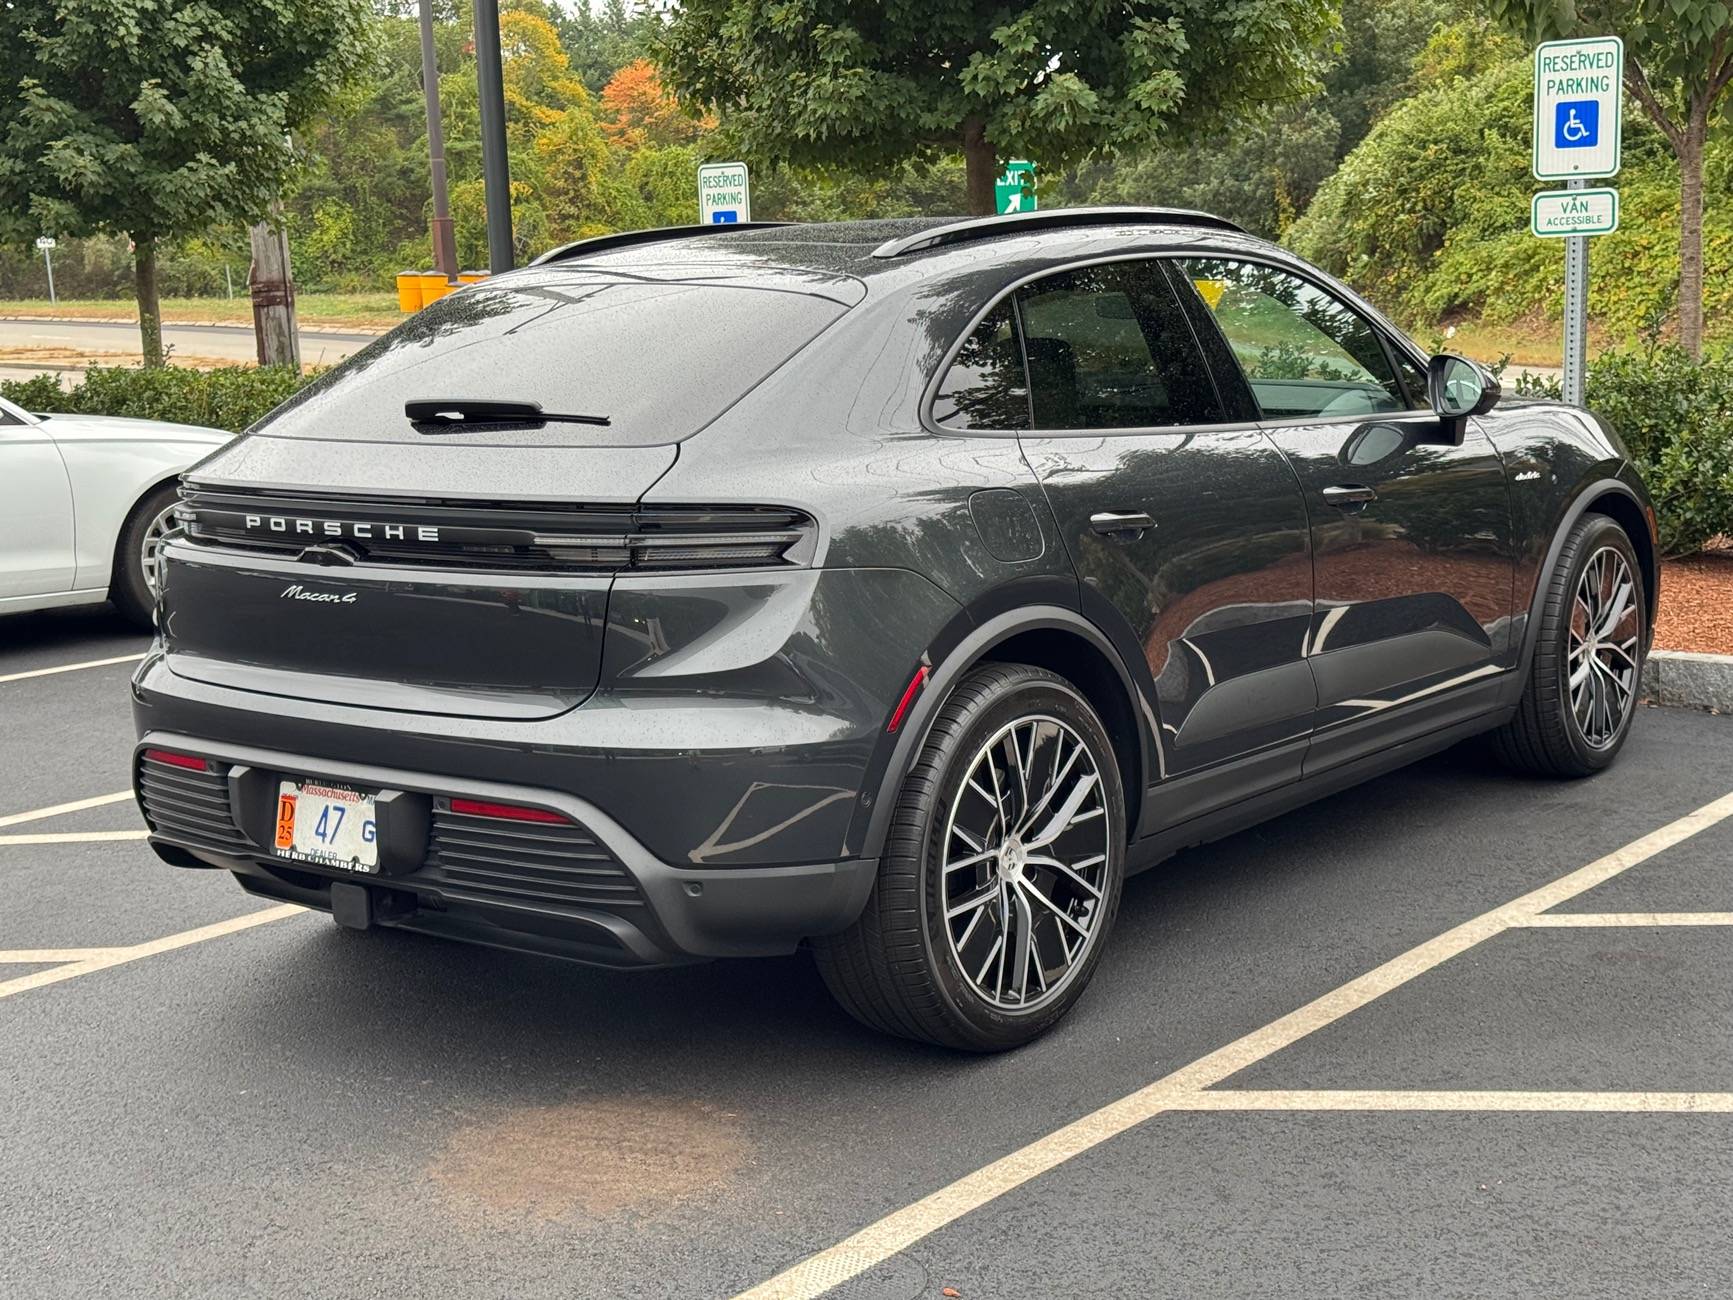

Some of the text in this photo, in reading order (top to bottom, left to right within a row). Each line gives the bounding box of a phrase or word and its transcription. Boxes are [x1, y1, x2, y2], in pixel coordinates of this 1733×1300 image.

[1543, 51, 1614, 73] RESERVED
[1546, 75, 1609, 96] PARKING
[702, 174, 743, 189] RESERVED
[706, 191, 742, 206] PARKING
[1561, 201, 1588, 214] VAN
[1546, 215, 1602, 226] ACCESSIBLE
[246, 515, 439, 542] PORSCHE
[280, 584, 340, 603] Macan
[301, 783, 361, 803] Massachusetts
[279, 801, 294, 822] D
[278, 825, 292, 840] 25
[315, 804, 376, 845] 47 G
[276, 849, 370, 873] HERB CHAMBERS
[310, 848, 337, 860] DEALER
